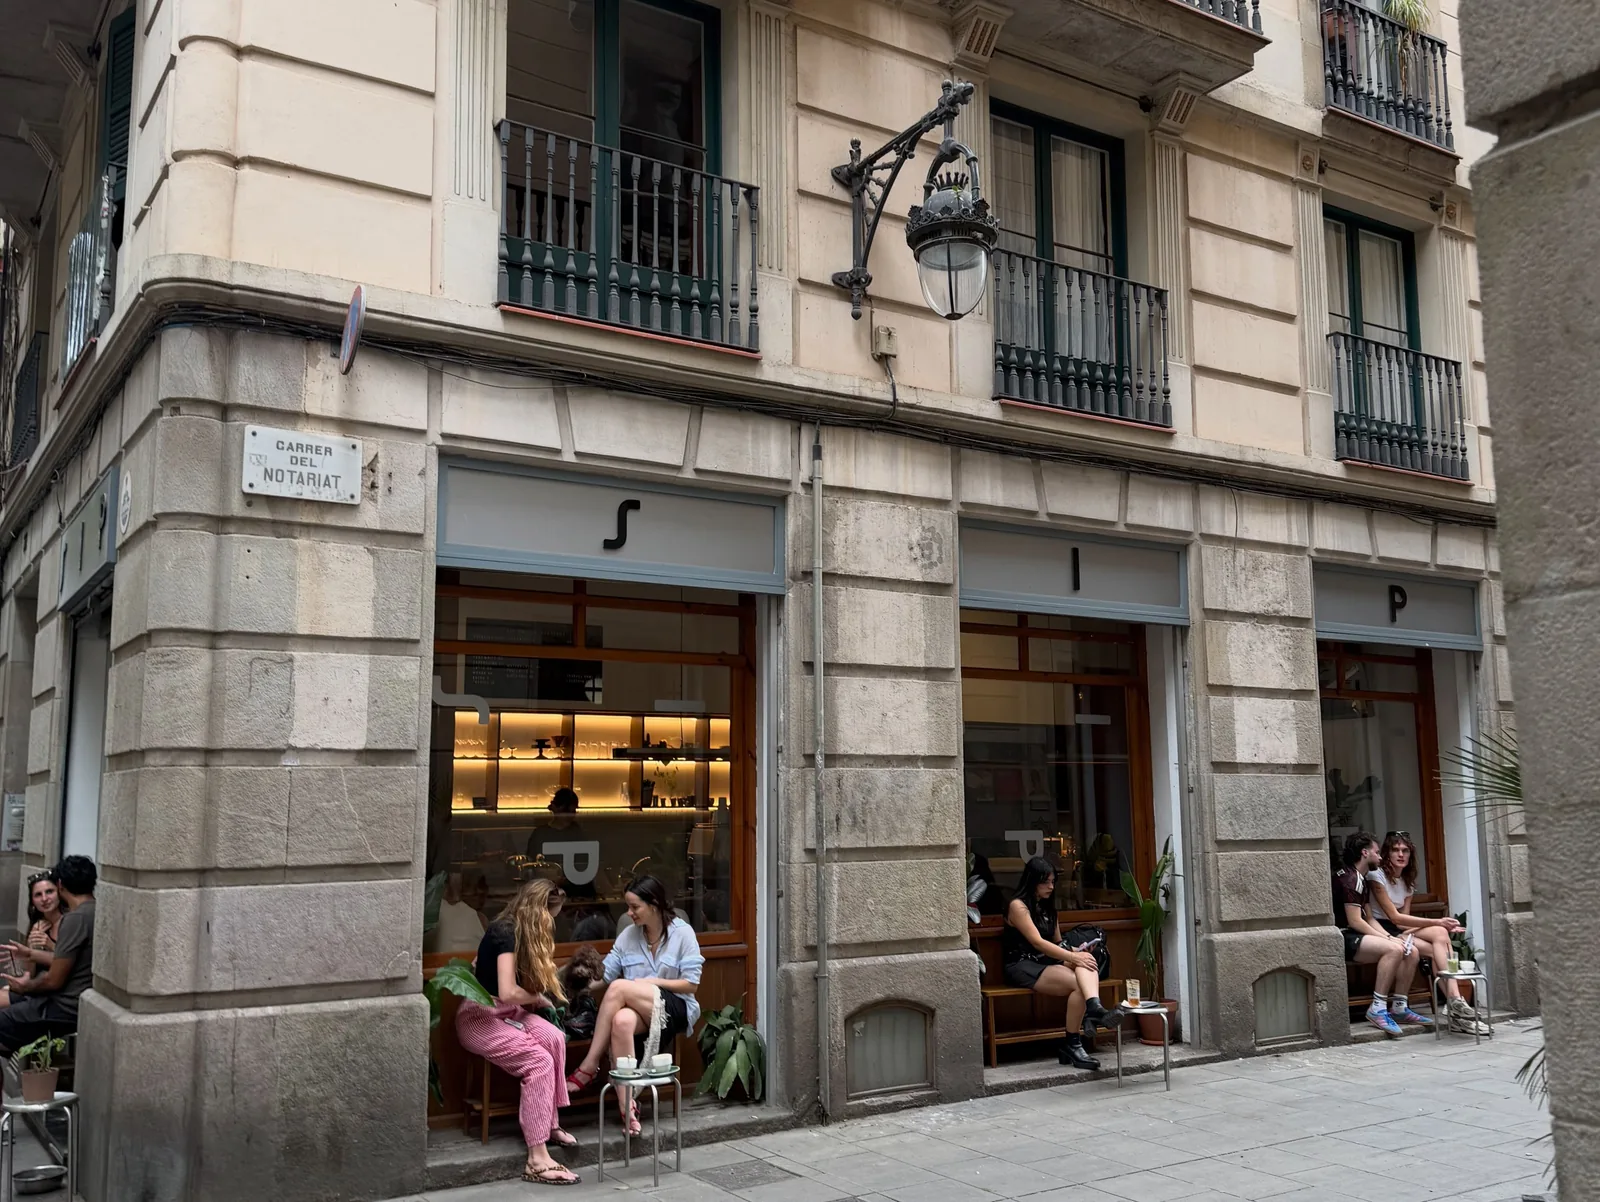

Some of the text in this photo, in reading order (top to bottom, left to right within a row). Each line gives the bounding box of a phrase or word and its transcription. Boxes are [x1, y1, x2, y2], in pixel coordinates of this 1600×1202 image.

[276, 440, 332, 456] CARRER
[290, 455, 317, 467] DEL
[263, 467, 341, 489] NOTARIAT
[1388, 584, 1407, 622] P
